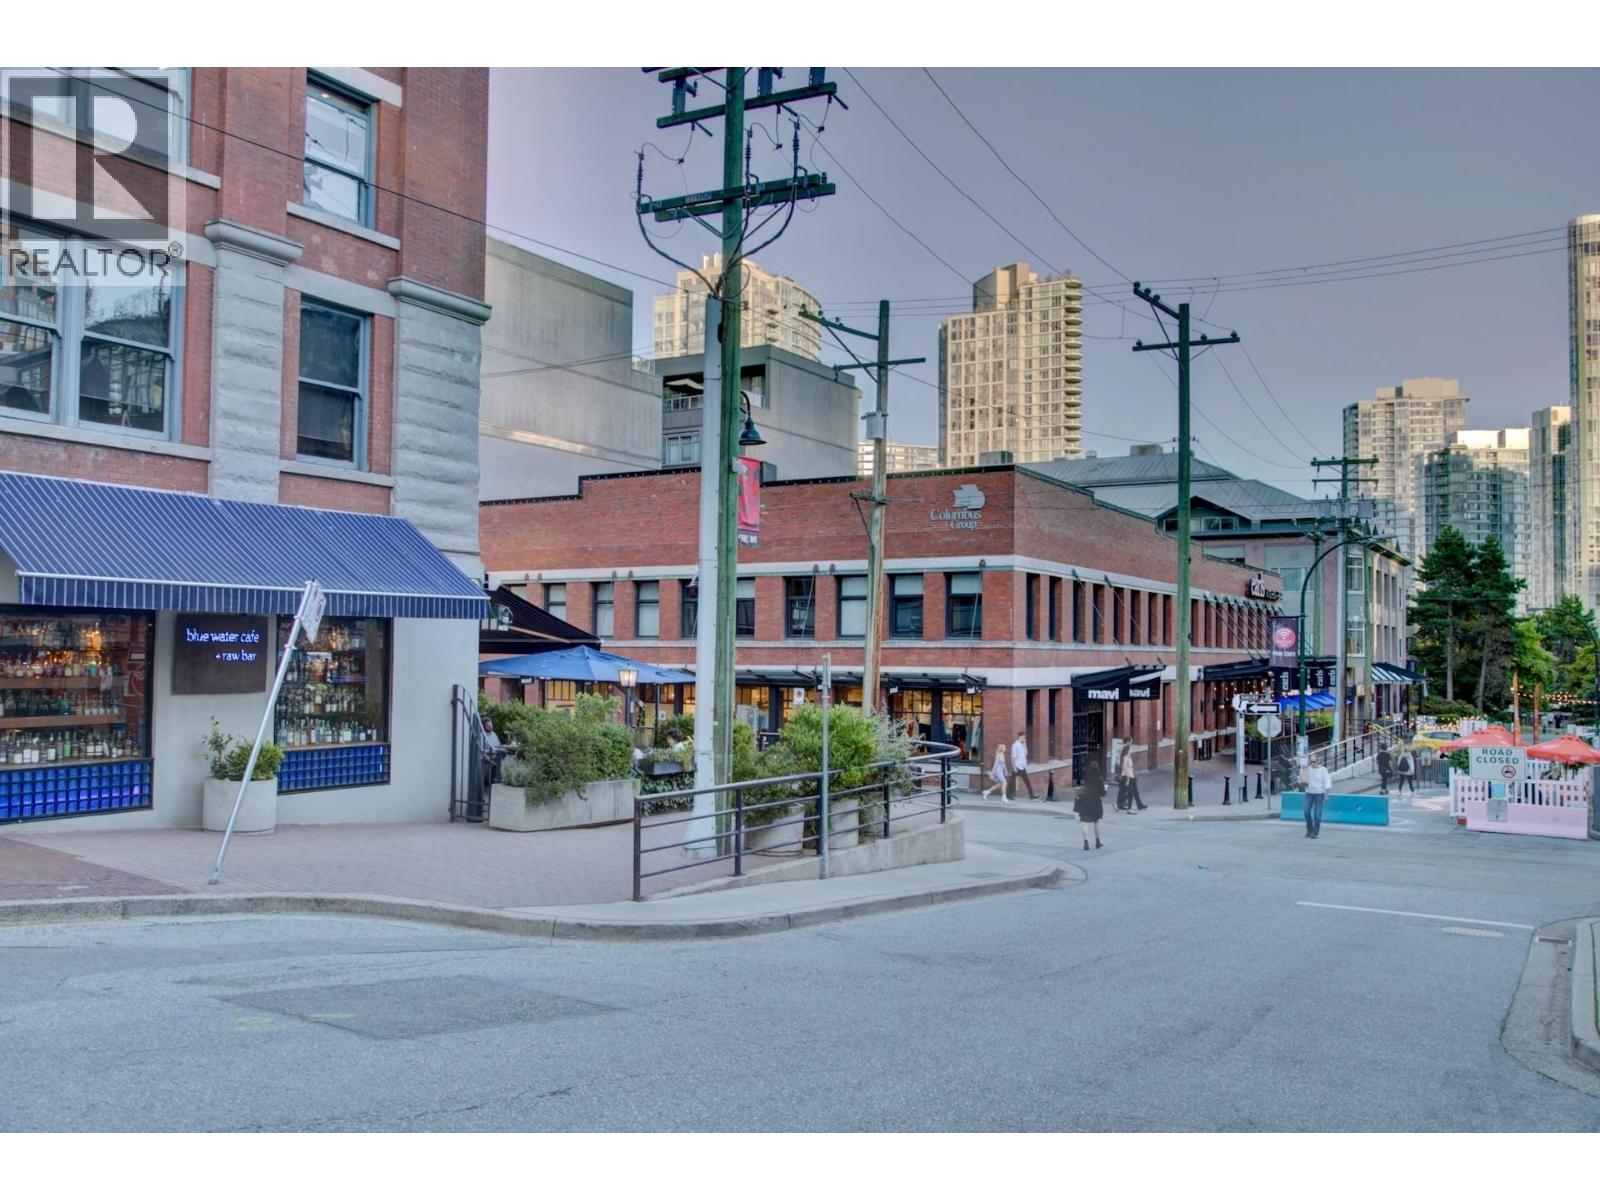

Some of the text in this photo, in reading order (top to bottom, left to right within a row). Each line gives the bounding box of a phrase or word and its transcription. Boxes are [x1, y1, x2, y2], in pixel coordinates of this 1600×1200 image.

[930, 508, 981, 520] Columbus
[950, 520, 977, 530] Group
[186, 628, 260, 643] blue water cafe
[222, 652, 240, 660] raw
[241, 649, 257, 661] bar
[1280, 671, 1289, 690] earls
[1315, 669, 1324, 687] earls
[1088, 688, 1119, 699] mavi
[1482, 748, 1513, 756] ROAD
[1476, 756, 1519, 764] CLOSED
